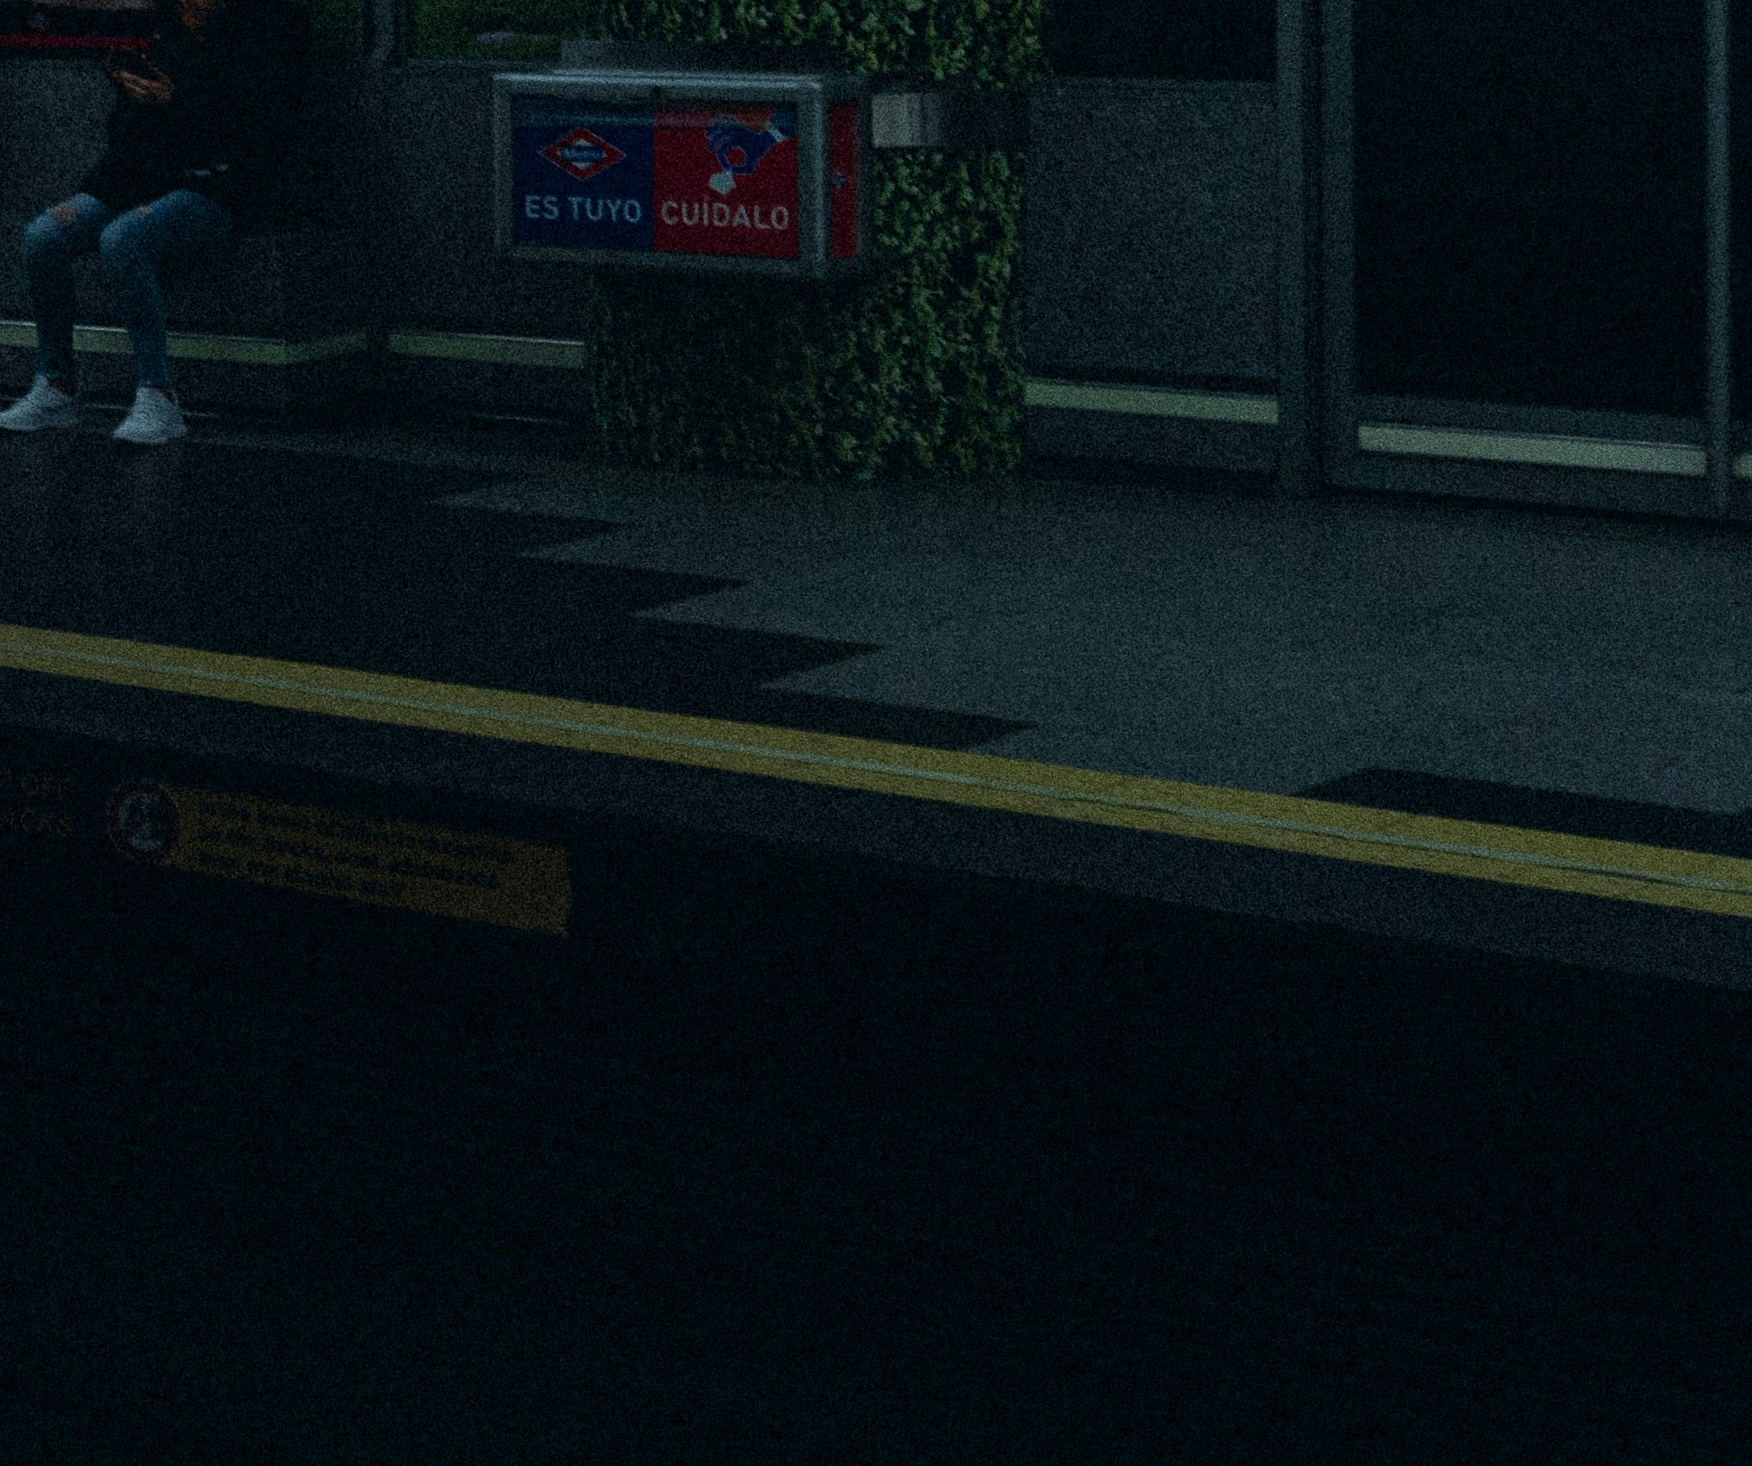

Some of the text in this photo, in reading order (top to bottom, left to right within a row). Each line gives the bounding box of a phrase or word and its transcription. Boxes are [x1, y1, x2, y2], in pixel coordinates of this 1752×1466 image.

[524, 194, 790, 231] ES TUYO CUÍDALO
